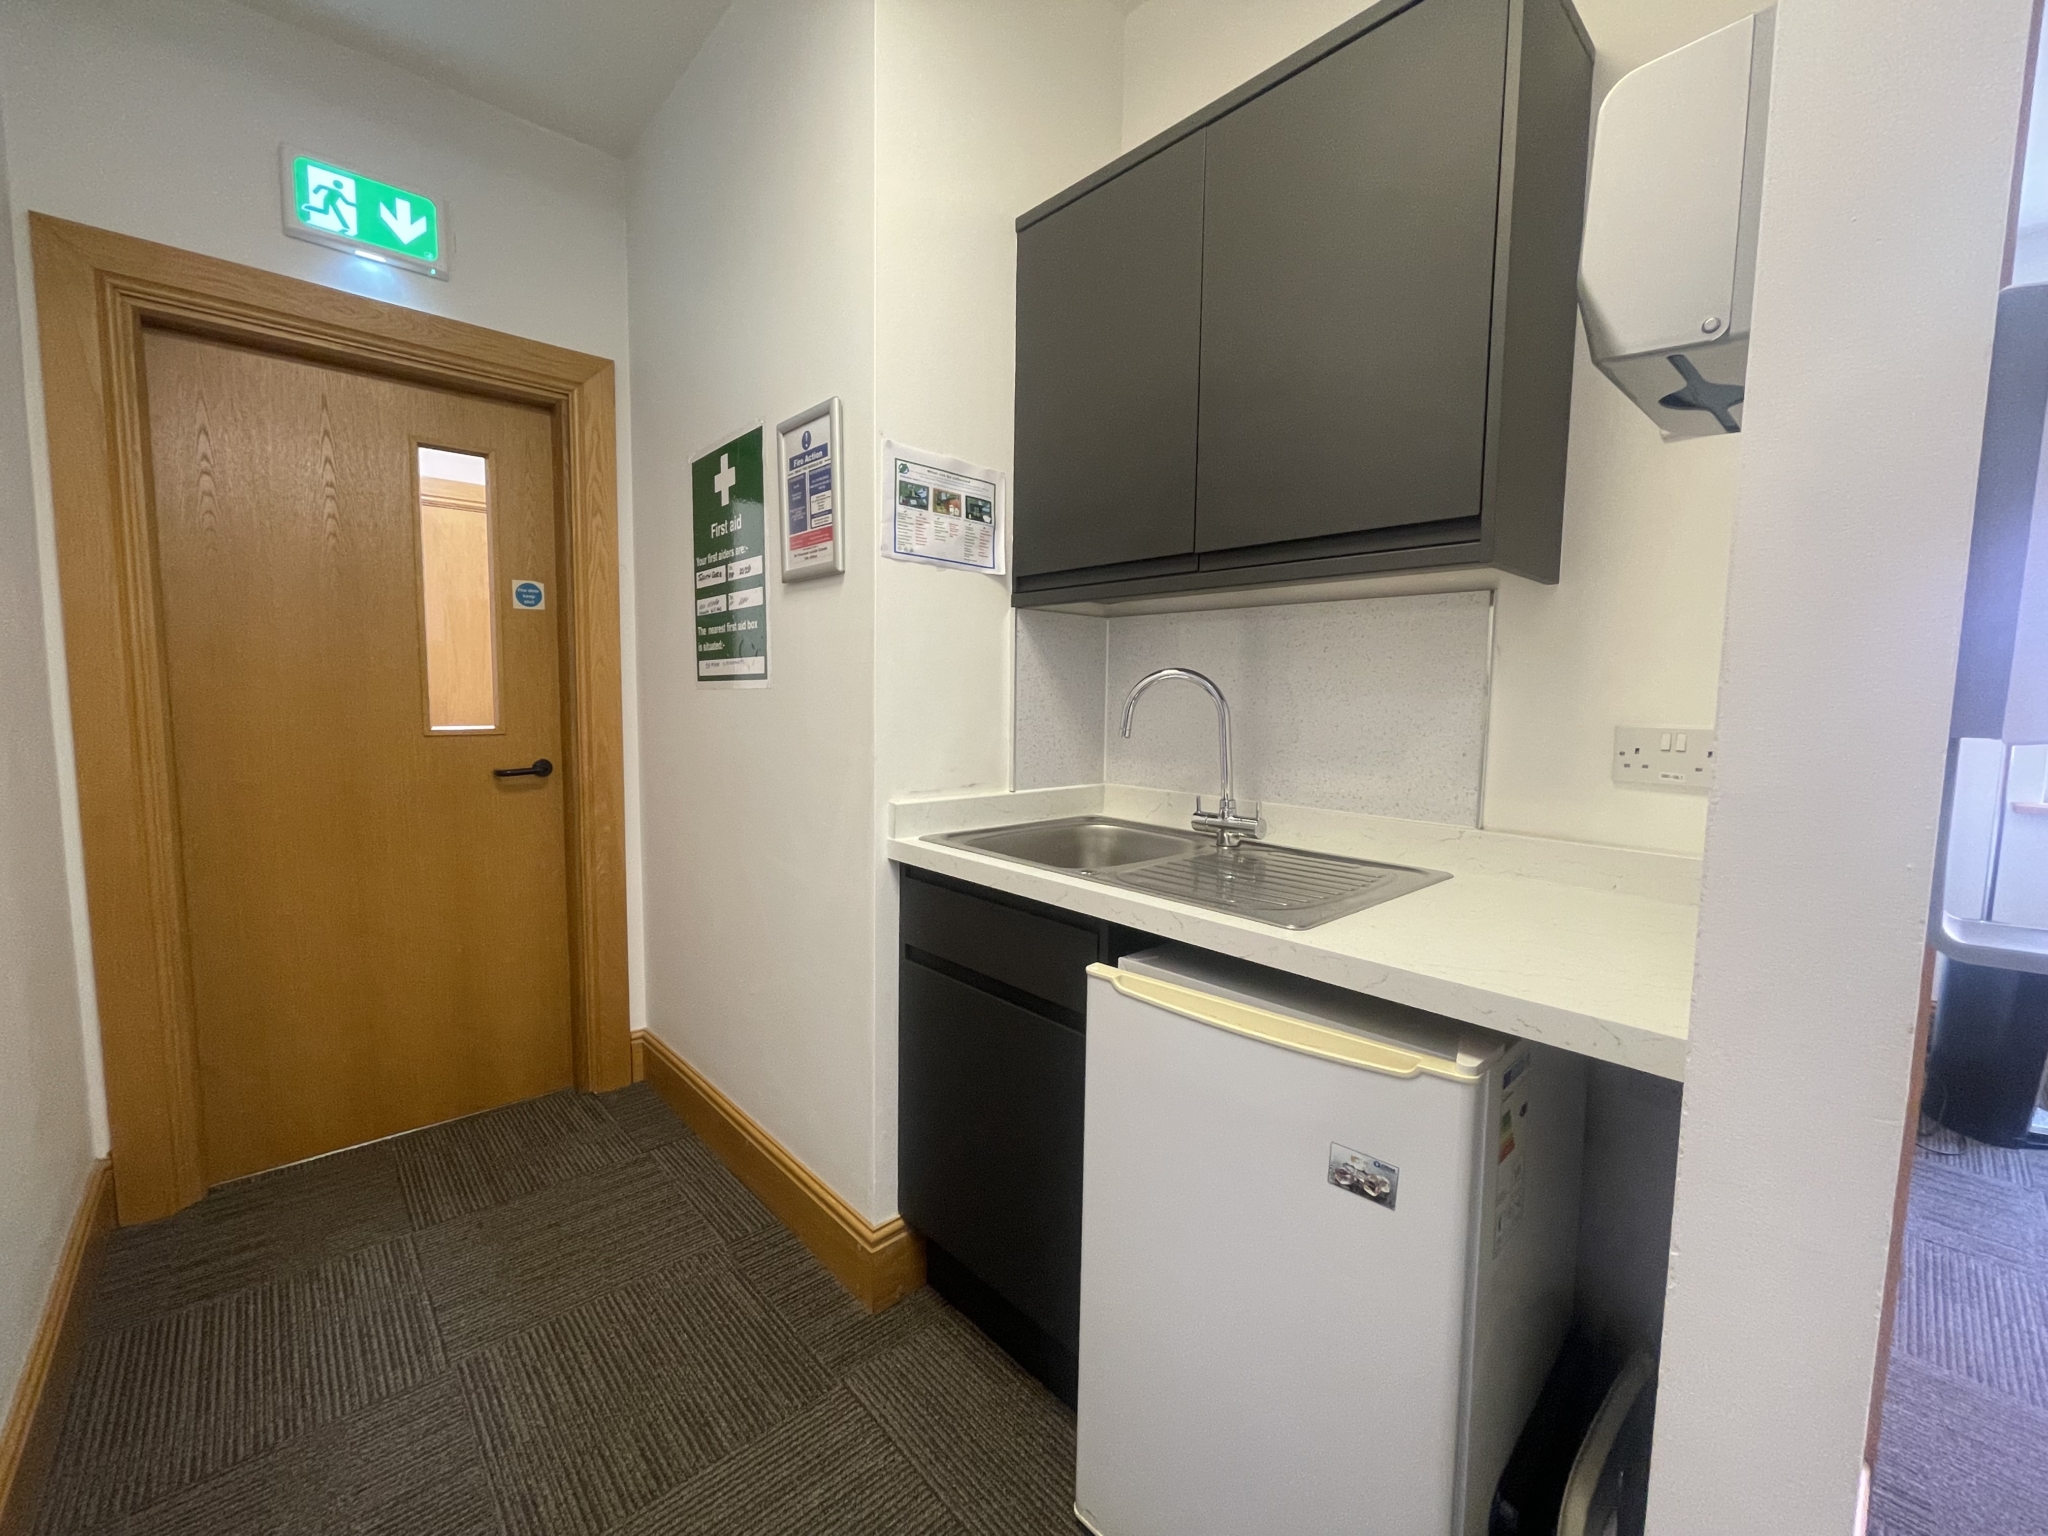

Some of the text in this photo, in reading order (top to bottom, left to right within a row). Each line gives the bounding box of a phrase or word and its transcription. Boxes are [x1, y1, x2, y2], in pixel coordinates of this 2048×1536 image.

[793, 458, 804, 468] Fire
[805, 450, 823, 463] Action
[711, 513, 742, 539] First aid
[696, 557, 707, 567] Your
[707, 552, 718, 563] first
[718, 549, 734, 561] aiders
[698, 619, 758, 636] The nearest first aid box
[698, 643, 703, 652] is
